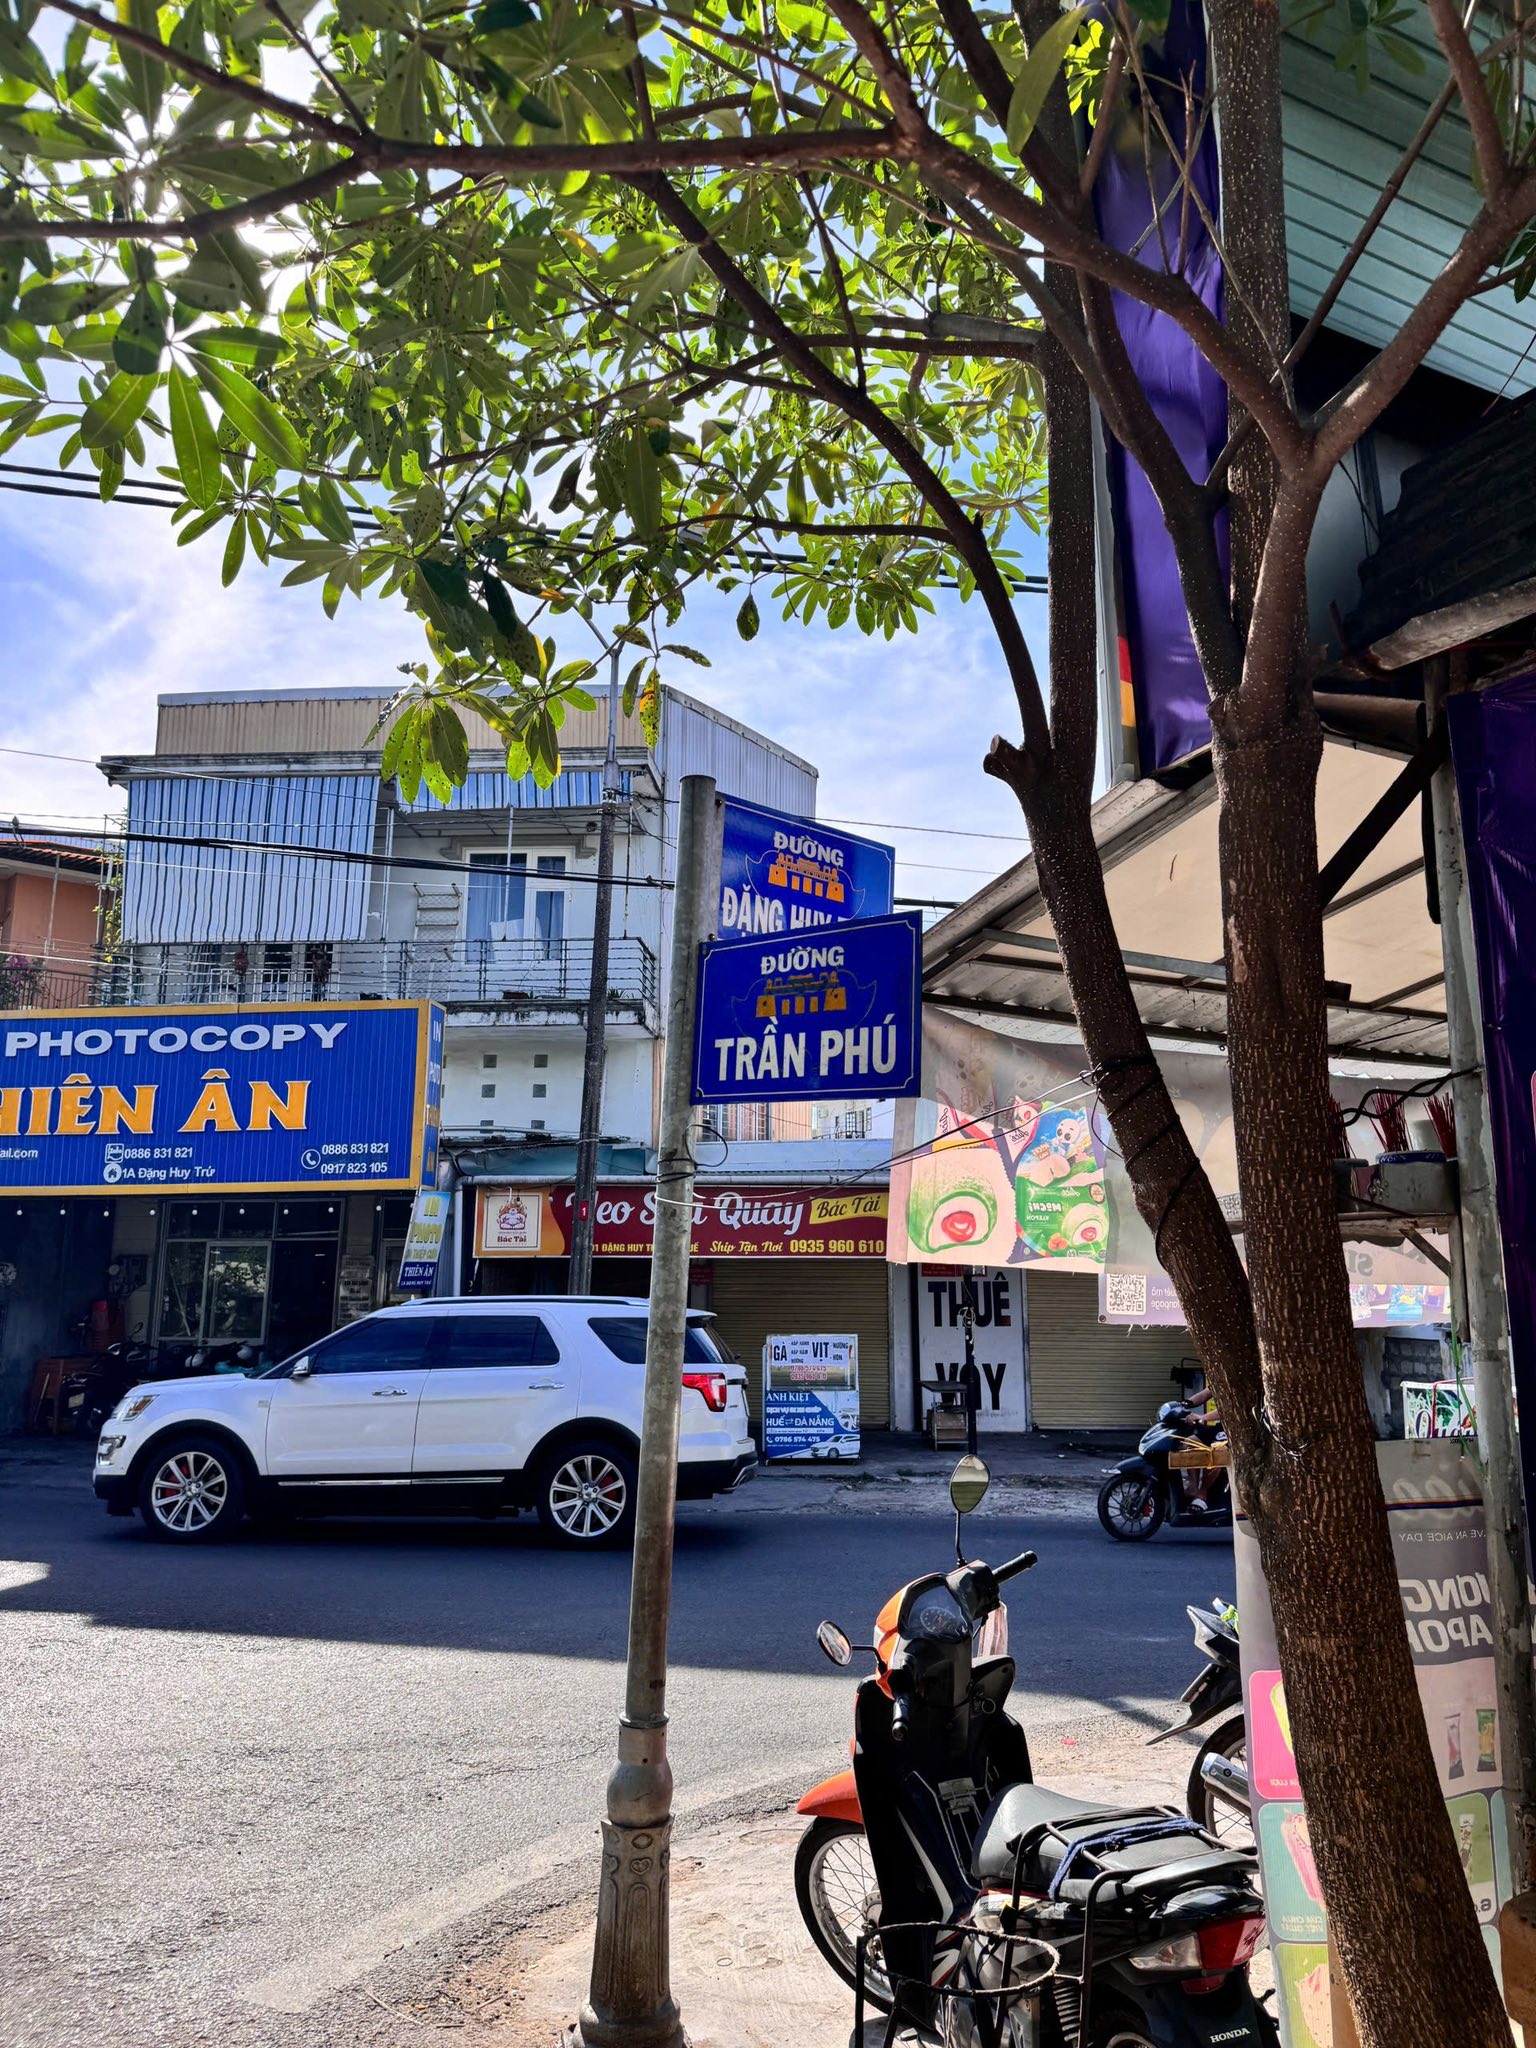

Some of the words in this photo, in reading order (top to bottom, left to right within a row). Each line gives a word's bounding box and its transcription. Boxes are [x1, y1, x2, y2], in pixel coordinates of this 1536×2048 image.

[773, 831, 844, 867] ĐƯỜNG
[722, 884, 784, 938] ĐẶNG
[760, 945, 845, 975] ĐƯỜNG
[5, 1022, 348, 1058] PHOTOCOPY
[714, 1016, 807, 1081] TRẦN
[819, 1013, 897, 1076] PHÚ
[178, 1068, 312, 1133] ÂN
[124, 1148, 151, 1159] 0886
[153, 1148, 172, 1159] 831
[174, 1147, 193, 1158] 821
[321, 1144, 348, 1156] 0886
[349, 1143, 369, 1155] 831
[370, 1142, 389, 1154] 821
[122, 1169, 136, 1179] 1A
[138, 1167, 166, 1181] Đặng
[168, 1167, 191, 1180] Huy
[320, 1163, 346, 1175] 0917
[347, 1162, 368, 1174] 823
[369, 1162, 388, 1173] 105
[718, 1191, 804, 1236] Quay
[816, 1198, 848, 1218] Bác
[851, 1195, 881, 1214] Tài
[497, 1235, 512, 1243] Bác
[513, 1235, 527, 1243] Tài
[601, 1241, 625, 1254] ĐẶNG
[627, 1243, 644, 1252] HUY
[709, 1240, 736, 1254] Ship
[738, 1241, 759, 1254] Tận
[790, 1240, 824, 1253] 0935
[828, 1240, 855, 1253] 960
[858, 1240, 884, 1253] 610
[928, 1270, 1012, 1328] THUÊ
[773, 1342, 787, 1361] GÀ
[812, 1342, 830, 1362] VỊT
[766, 1392, 788, 1402] ANH
[788, 1391, 810, 1402] KIỆT
[766, 1415, 785, 1426] HUẾ
[794, 1415, 808, 1426] ĐÀ
[1209, 2027, 1251, 2043] HONDA
